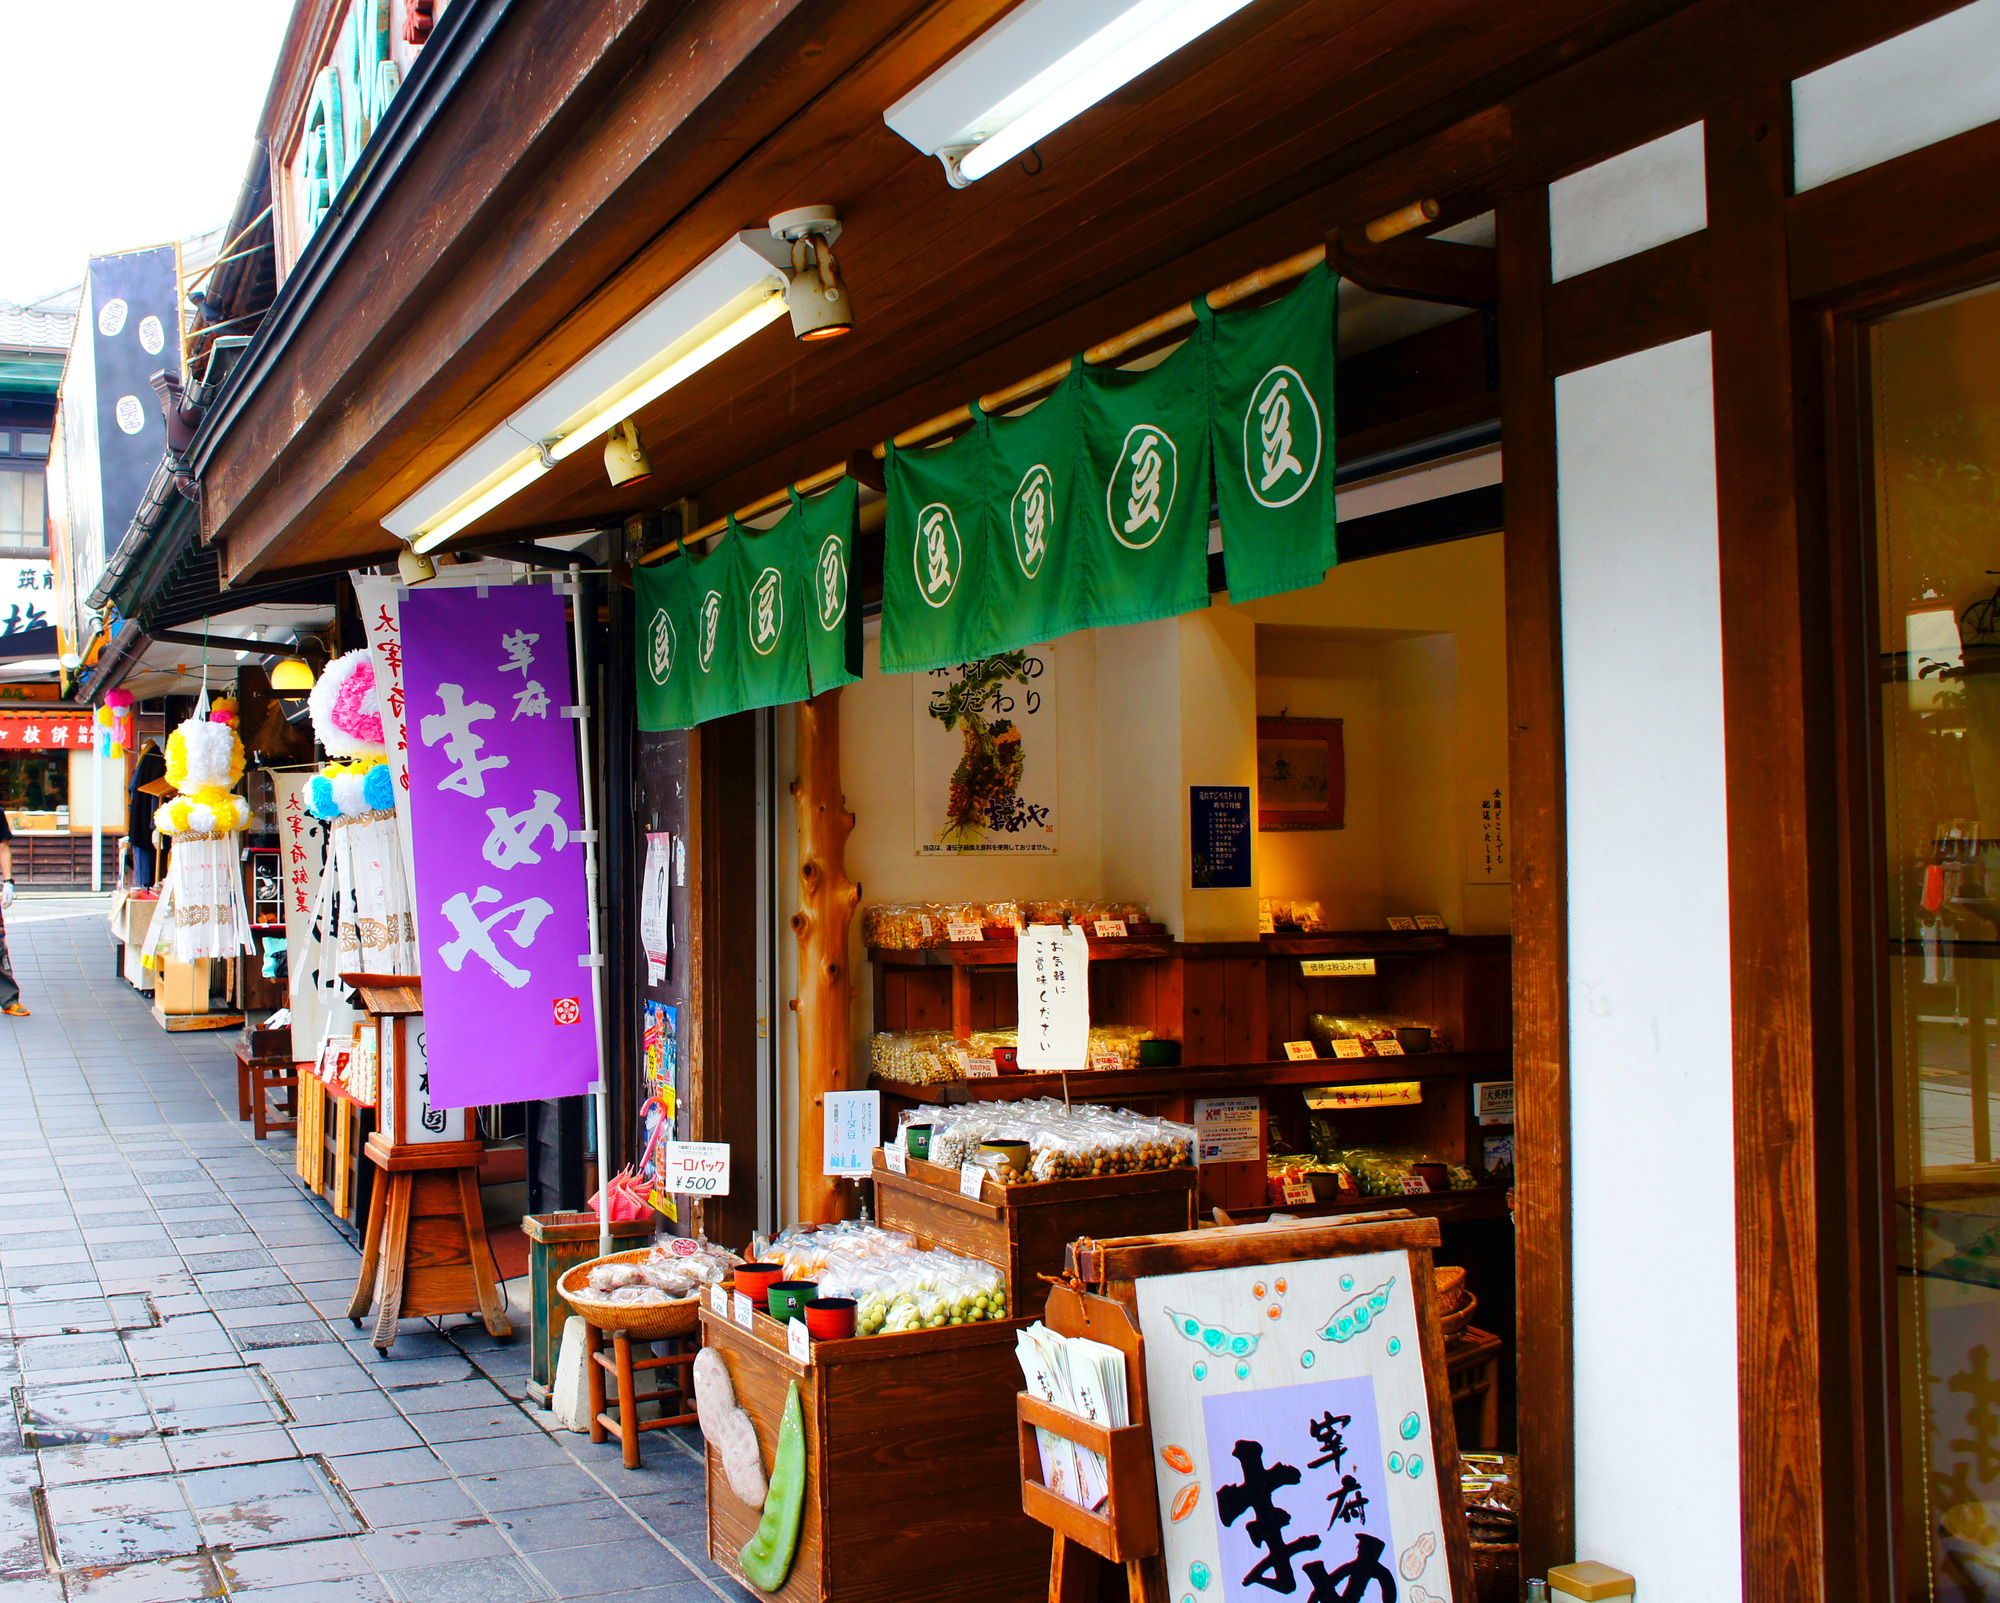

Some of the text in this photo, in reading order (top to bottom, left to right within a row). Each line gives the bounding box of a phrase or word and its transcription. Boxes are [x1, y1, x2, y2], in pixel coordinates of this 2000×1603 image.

[497, 629, 551, 722] 宰府
[928, 689, 1042, 715] こだわり
[420, 682, 569, 990] まめや
[1050, 941, 1066, 994] お気軽に
[1310, 962, 1368, 973] 価格は税込みです
[1035, 941, 1051, 1051] ご賞味ください
[847, 1100, 856, 1140] ソーダ豆
